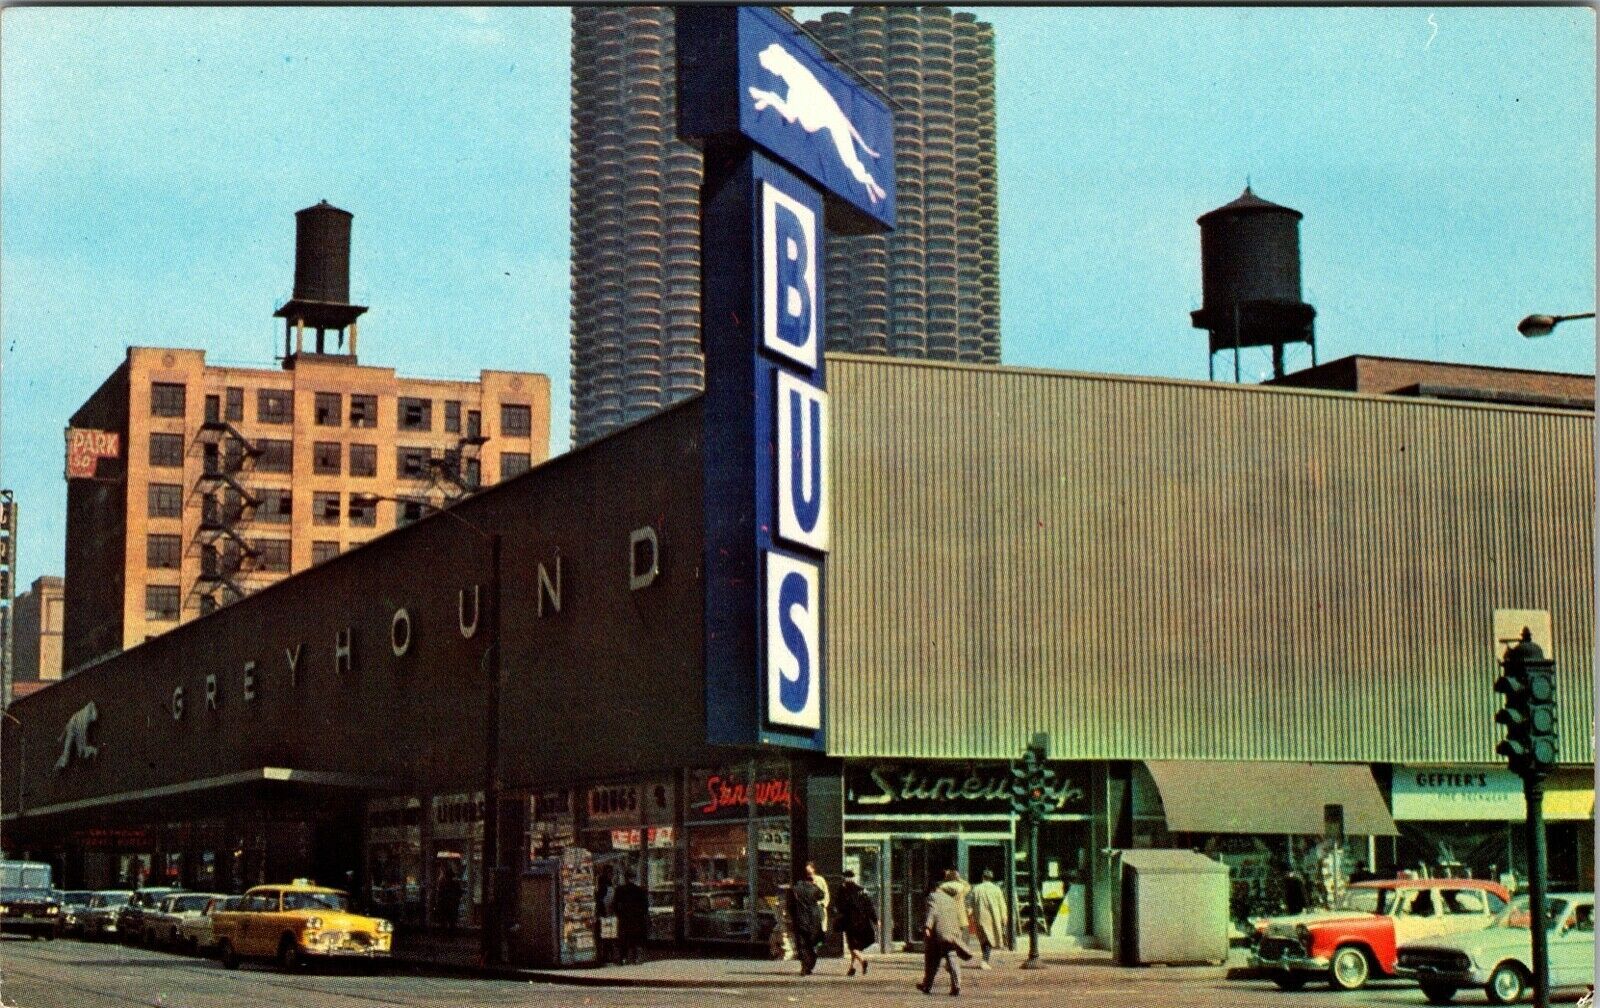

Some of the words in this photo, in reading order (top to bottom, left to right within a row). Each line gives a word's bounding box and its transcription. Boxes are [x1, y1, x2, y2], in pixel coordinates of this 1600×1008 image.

[73, 431, 118, 455] PARK
[774, 201, 822, 714] BUS
[172, 525, 659, 720] GREYHOUND
[858, 766, 1083, 809] Stinewy
[1416, 772, 1487, 787] GEFTER'S
